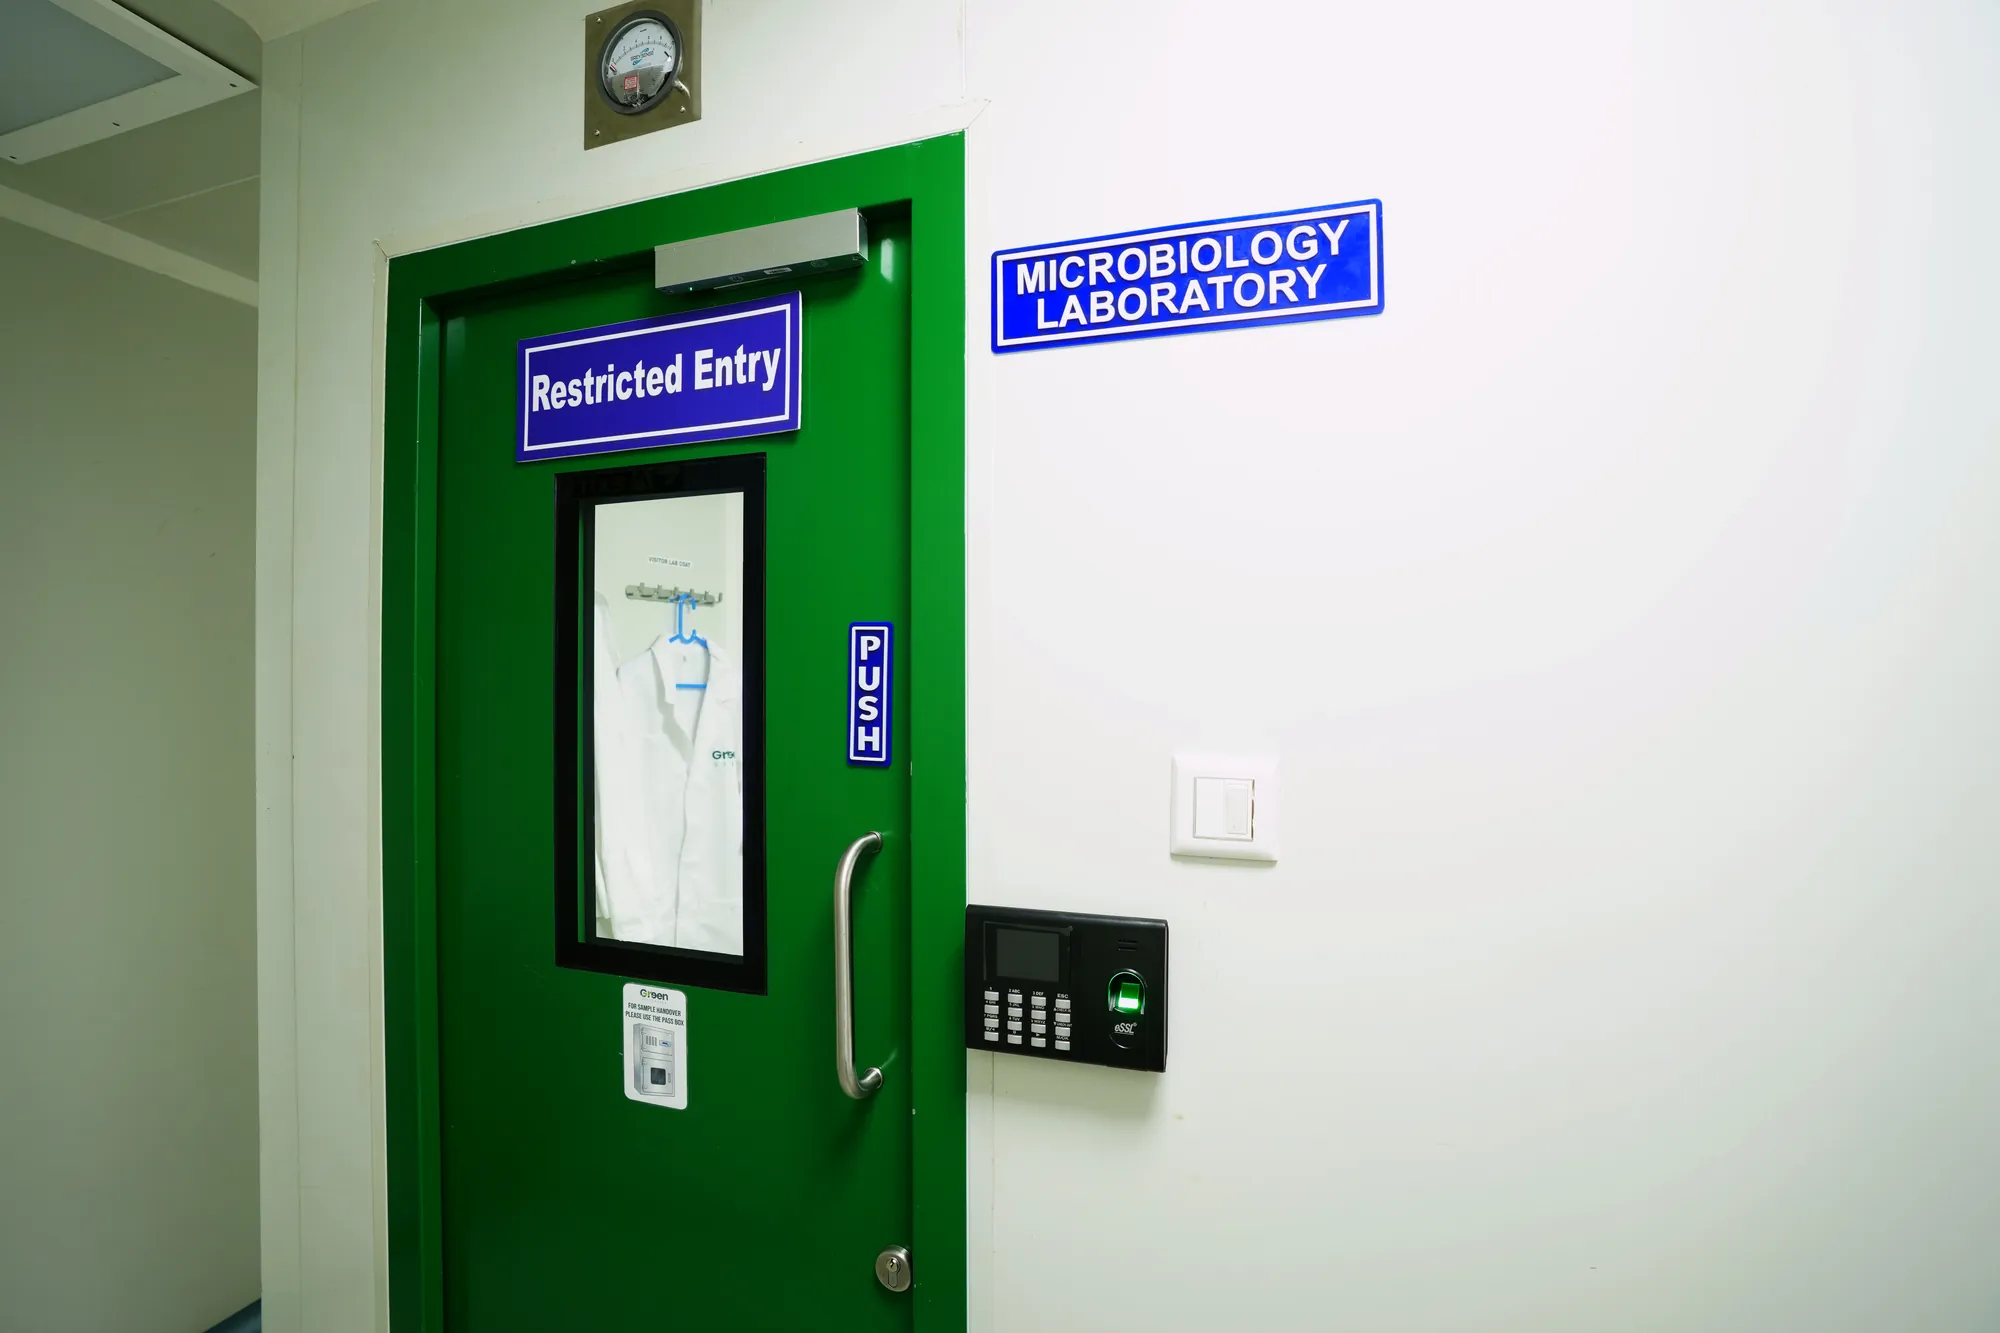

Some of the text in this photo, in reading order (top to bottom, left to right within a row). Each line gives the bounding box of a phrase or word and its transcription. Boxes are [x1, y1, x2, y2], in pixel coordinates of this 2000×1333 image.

[1016, 219, 1350, 295] MICROBIOLOGY
[1036, 263, 1328, 330] LABORATORY
[532, 344, 781, 412] Restricted Entry
[857, 635, 881, 752] PUSH
[625, 1010, 685, 1026] PLEASE USE THE PASS BOX
[637, 1003, 656, 1013] SAMPLE
[656, 1007, 682, 1017] HANDOVER
[640, 988, 669, 1001] Green
